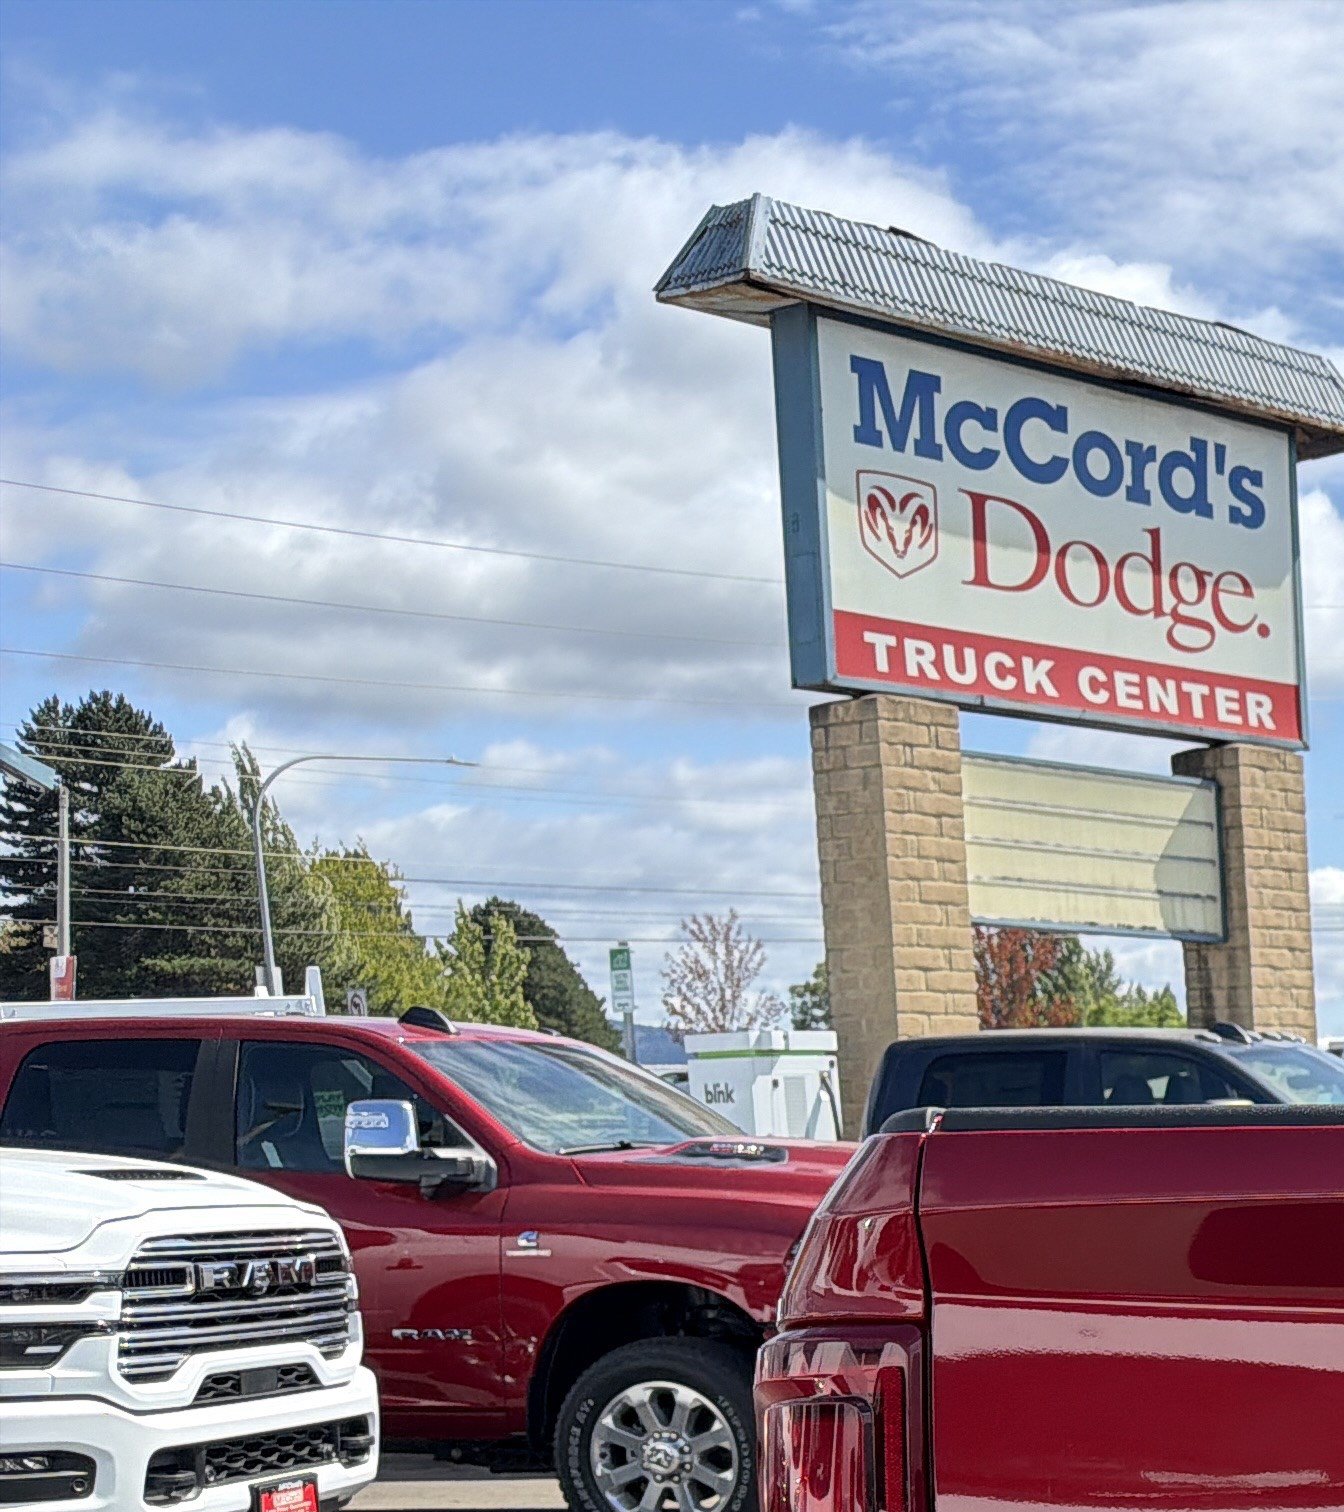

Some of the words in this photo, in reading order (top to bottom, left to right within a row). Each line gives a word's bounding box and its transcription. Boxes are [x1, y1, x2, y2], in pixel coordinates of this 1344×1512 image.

[849, 354, 1266, 530] McCord's
[862, 630, 1059, 699] TRUCK
[1077, 664, 1278, 732] CENTER
